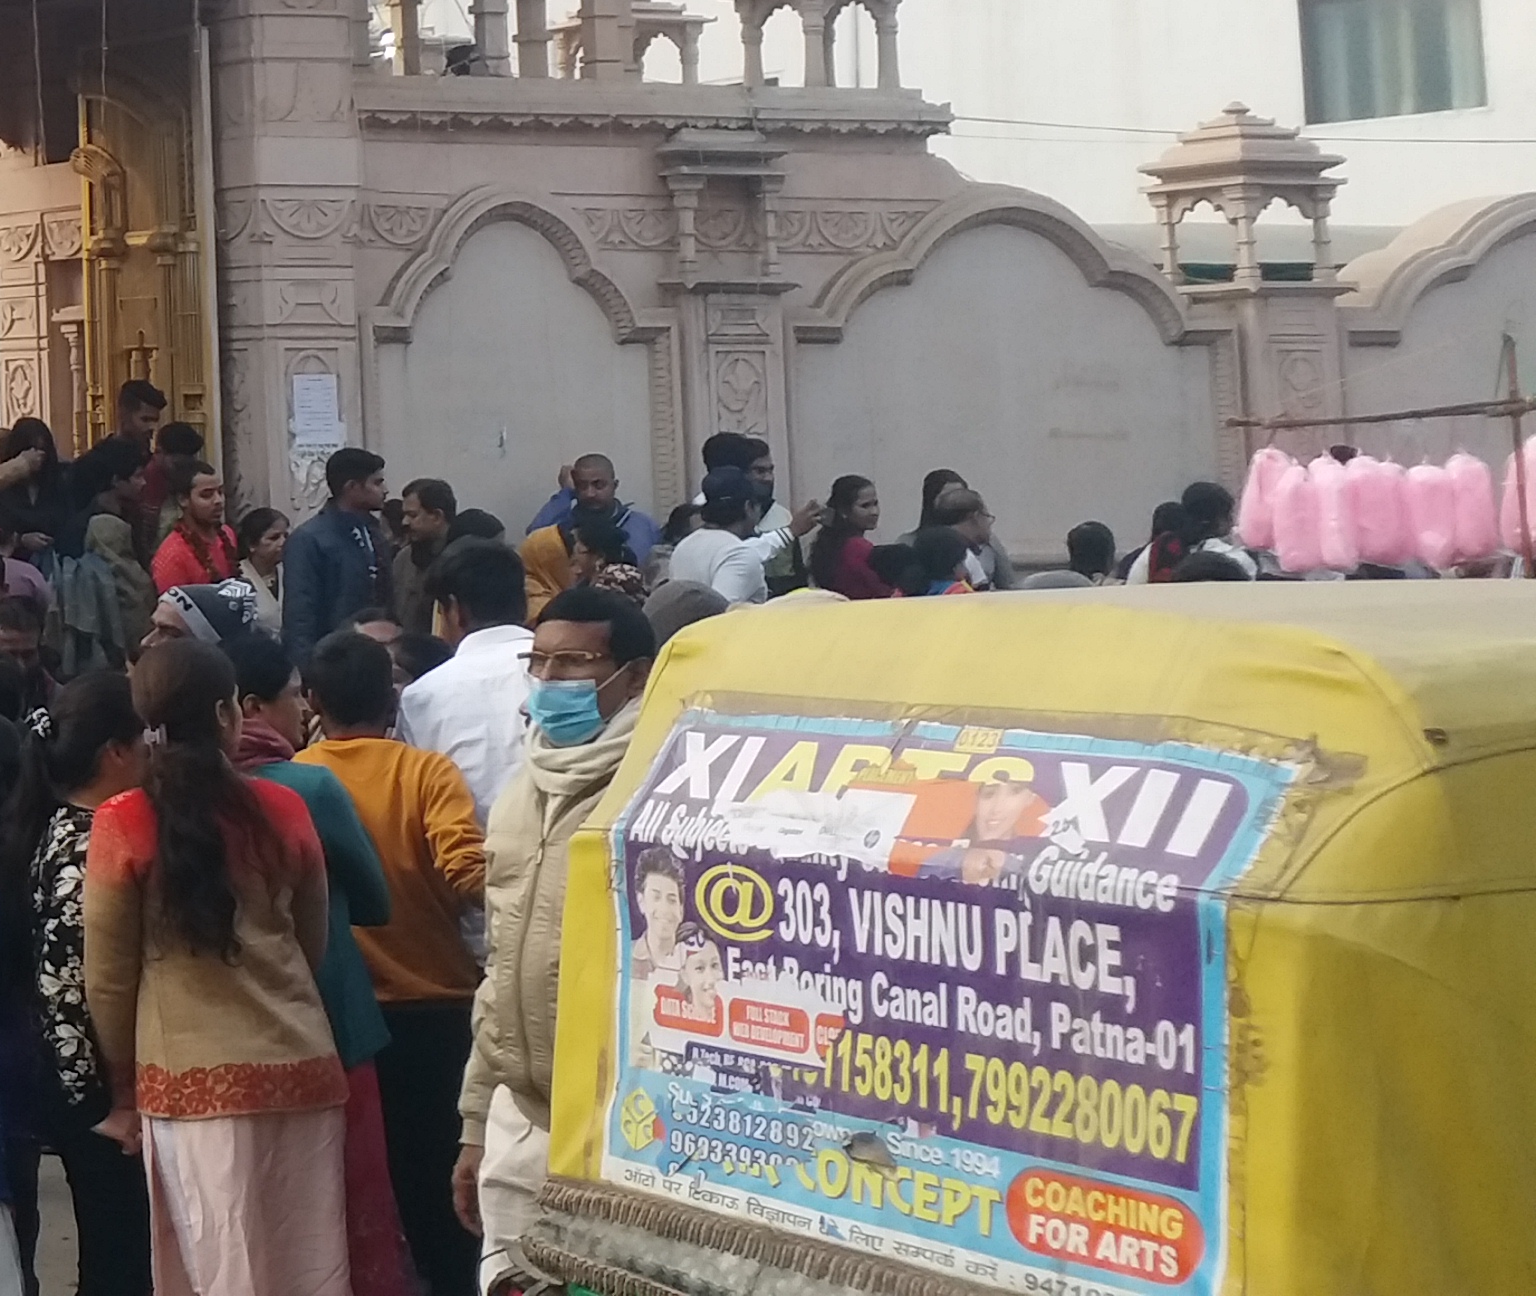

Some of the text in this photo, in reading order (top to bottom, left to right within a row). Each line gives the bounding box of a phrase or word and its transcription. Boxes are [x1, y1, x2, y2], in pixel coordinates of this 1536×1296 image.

[630, 800, 670, 844] All
[1040, 761, 1233, 857] XII
[1028, 846, 1180, 913] Guidance
[695, 864, 1136, 1014] @ 303, VISHNU PLACE,
[871, 971, 948, 1028] Canal
[957, 985, 1041, 1056] Road,
[1050, 1002, 1195, 1074] Patna-01
[663, 1179, 682, 1194] पर
[848, 1225, 885, 1251] लिए
[966, 1259, 999, 1281] करें
[1025, 1178, 1184, 1240] COACHING
[1028, 1214, 1179, 1279] FOR ARTS
